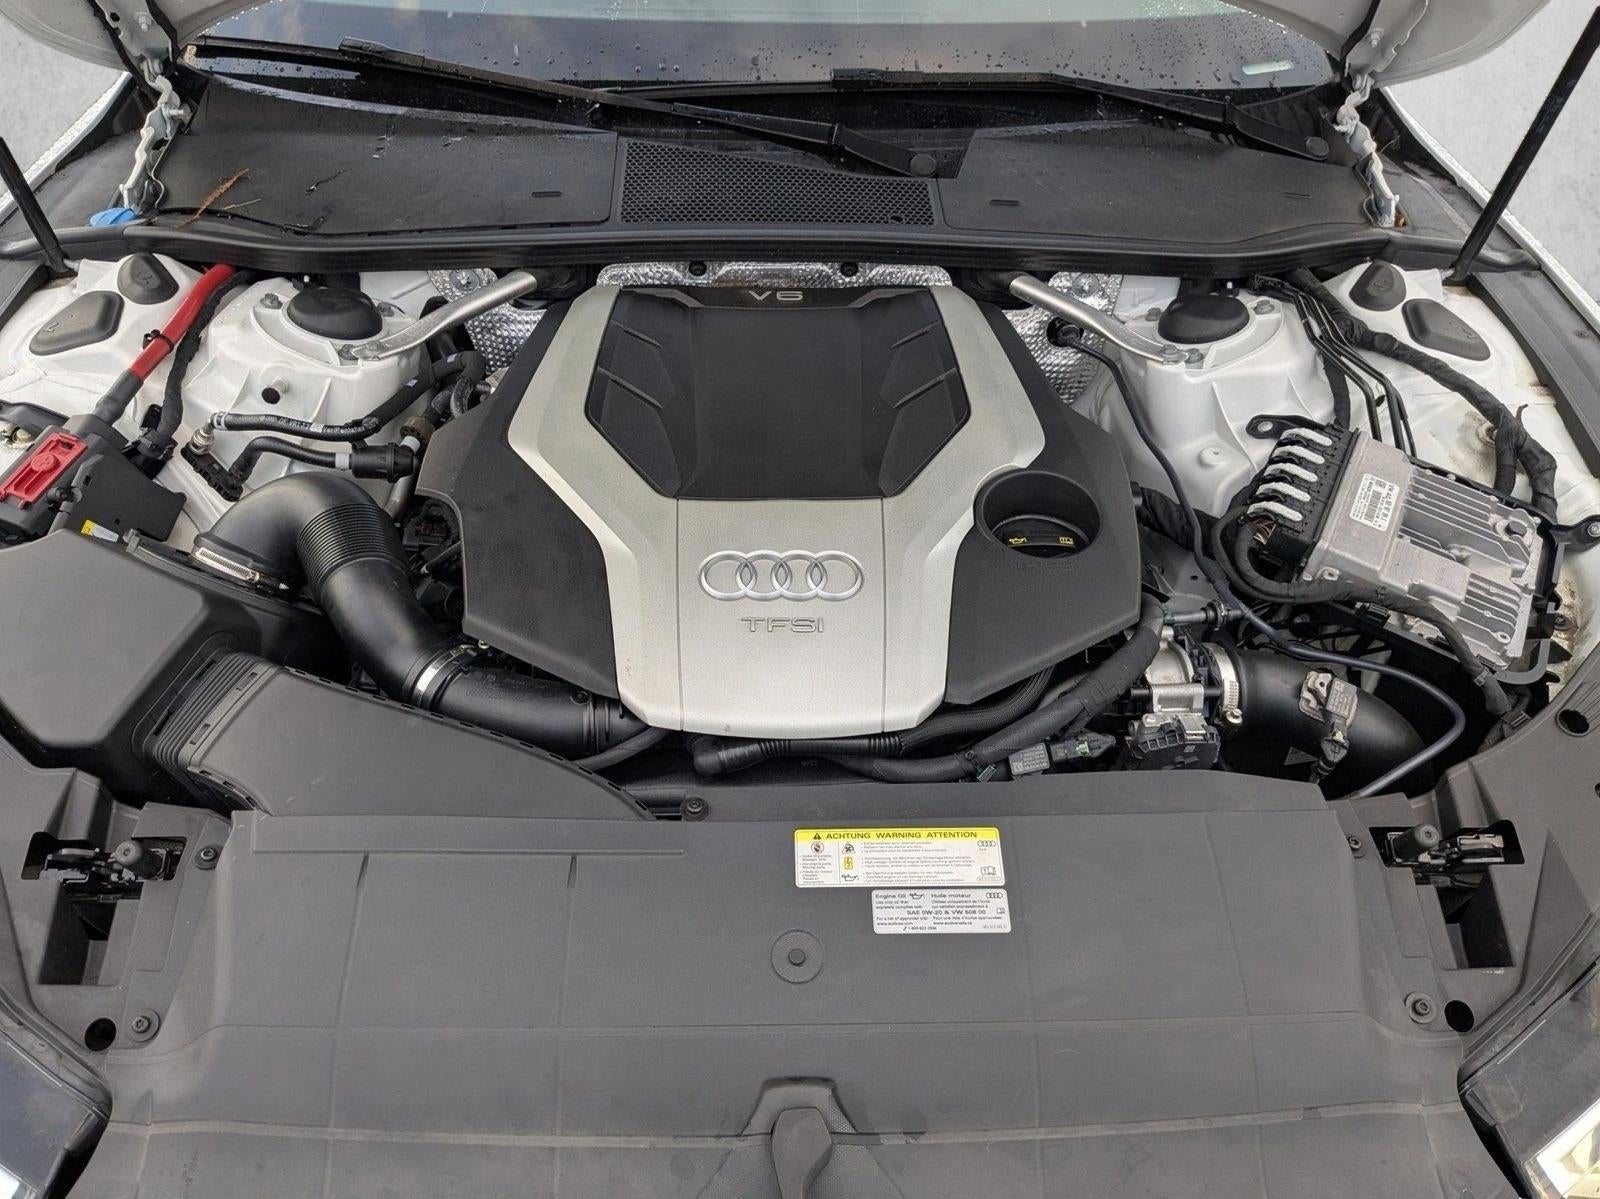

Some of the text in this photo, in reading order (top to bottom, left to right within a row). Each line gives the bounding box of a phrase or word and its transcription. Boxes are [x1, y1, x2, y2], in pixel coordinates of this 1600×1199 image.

[748, 290, 804, 302] V6
[741, 616, 824, 634] TFSI
[826, 832, 978, 840] ACHTUNG WARNING ATTENTION
